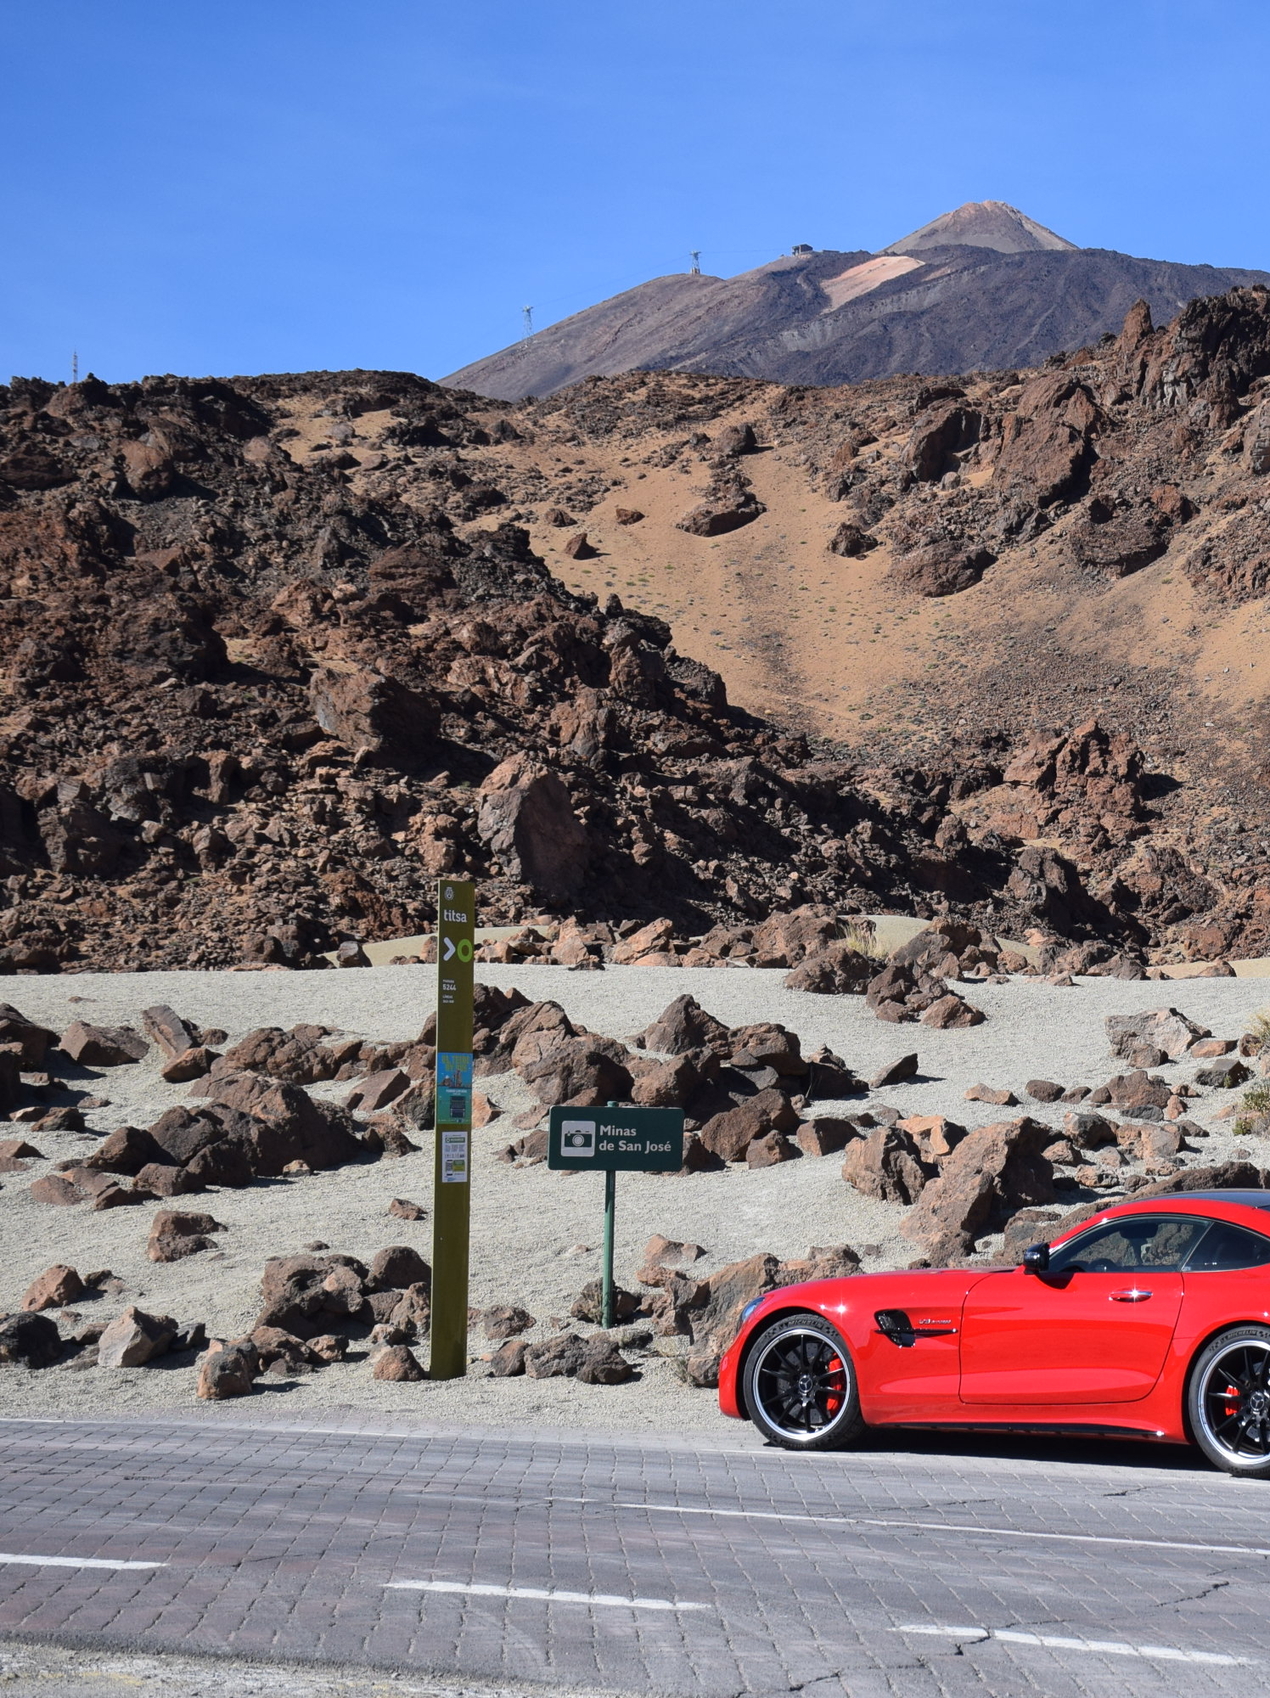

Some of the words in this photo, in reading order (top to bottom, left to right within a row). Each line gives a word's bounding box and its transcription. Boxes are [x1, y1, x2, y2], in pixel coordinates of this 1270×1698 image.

[443, 909, 468, 923] titsa
[442, 983, 457, 991] 5244
[599, 1125, 637, 1137] Minas
[598, 1140, 615, 1152] de
[618, 1140, 642, 1152] San
[644, 1141, 672, 1154] José
[788, 1319, 824, 1330] MICHELIN
